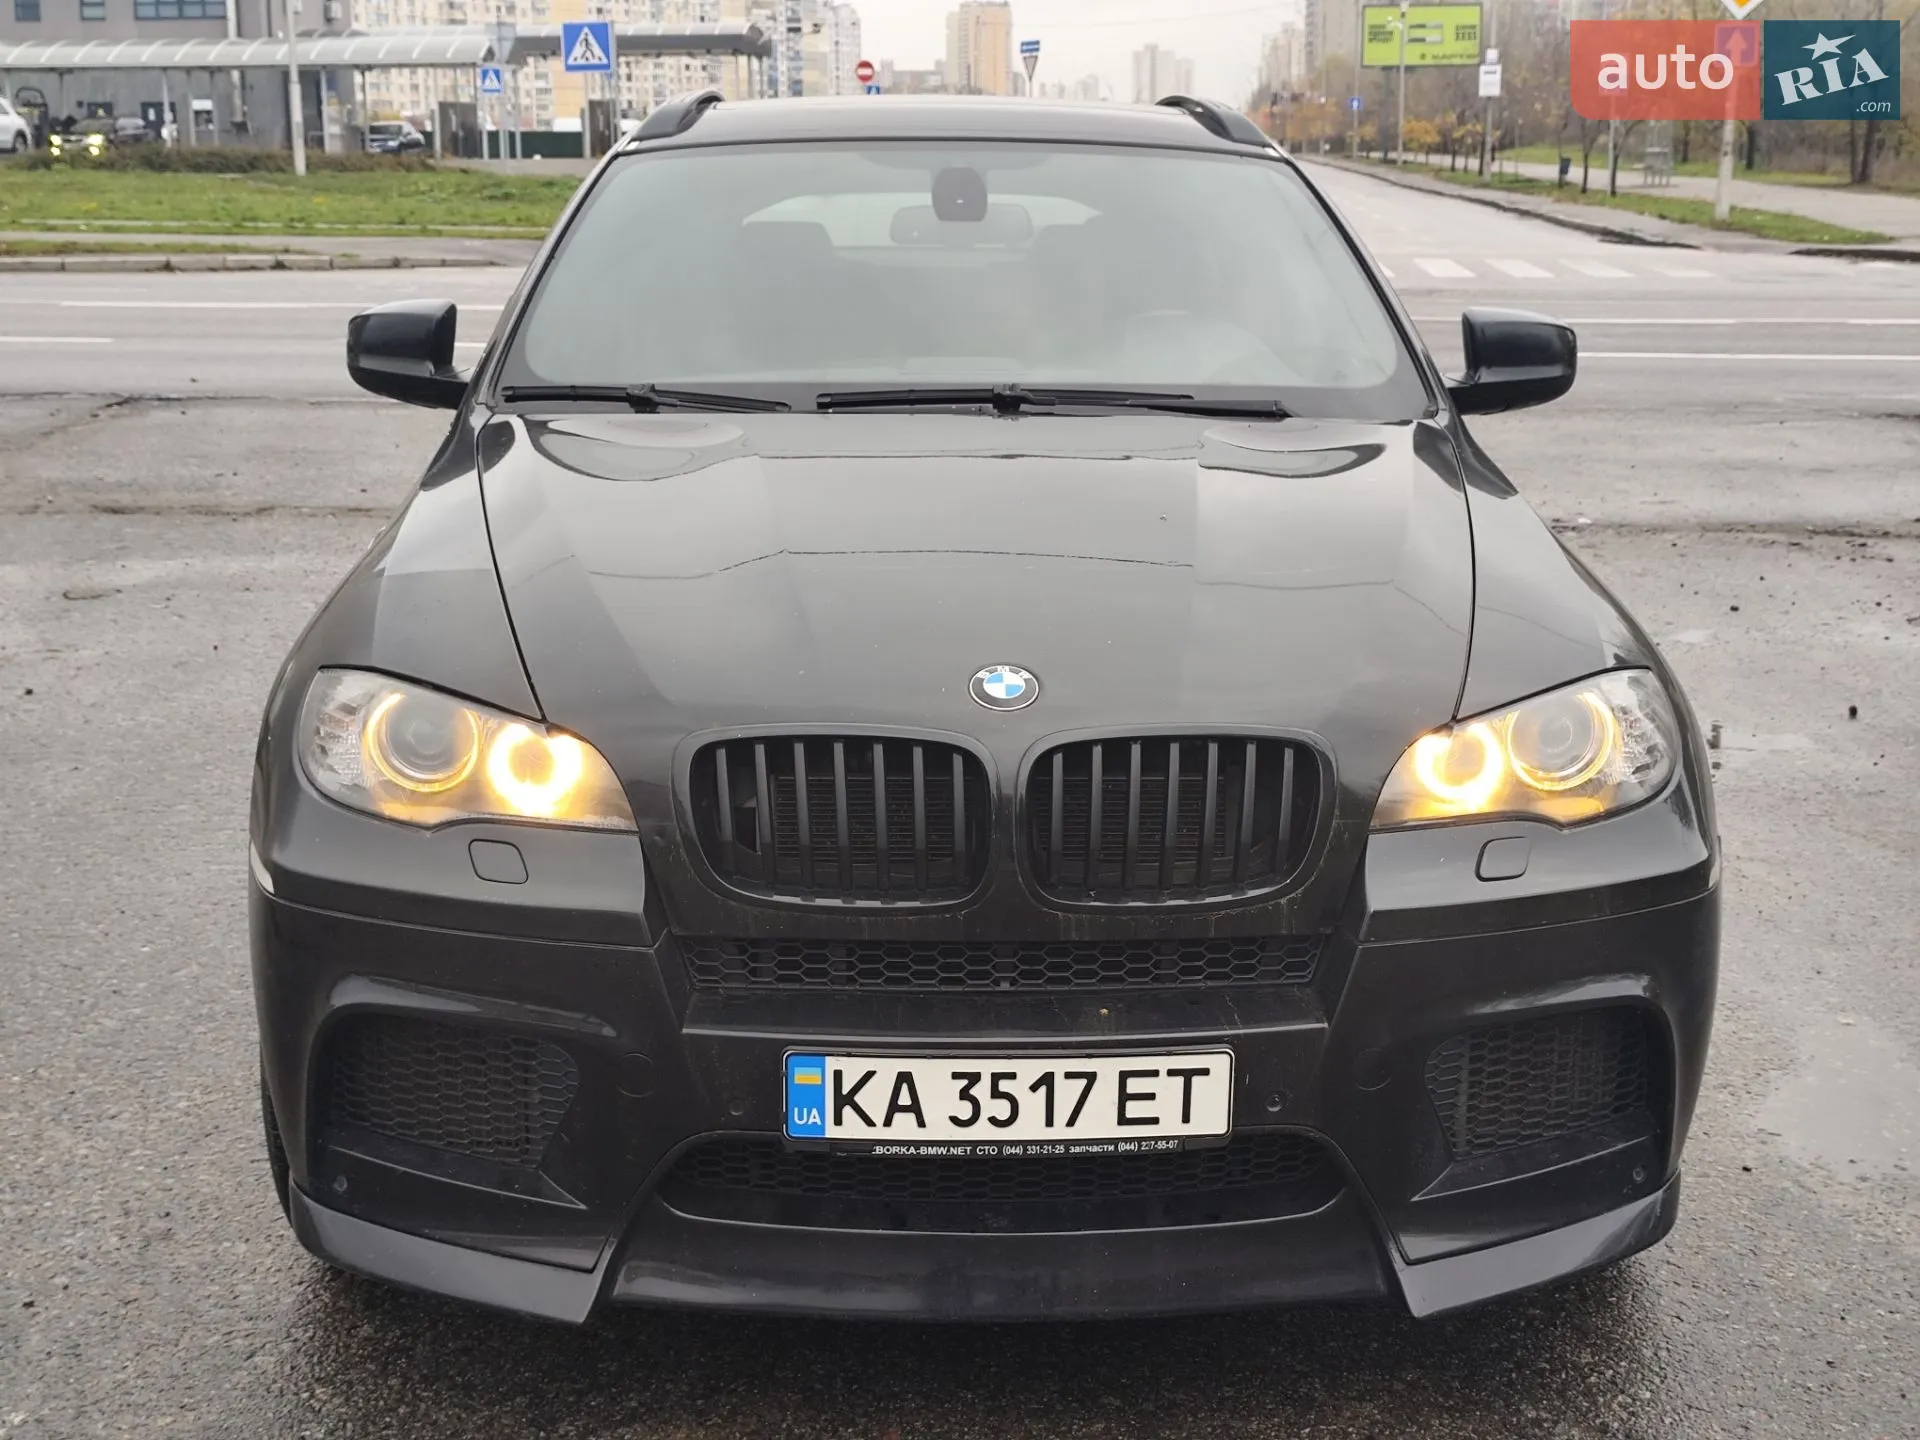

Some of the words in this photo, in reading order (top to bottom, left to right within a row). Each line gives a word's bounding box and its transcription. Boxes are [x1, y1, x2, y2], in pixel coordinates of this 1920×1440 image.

[833, 1069, 926, 1128] KA
[947, 1070, 1098, 1129] 3517
[1117, 1067, 1211, 1126] ET
[793, 1107, 822, 1125] UA
[1002, 1144, 1024, 1156] (044)
[1026, 1144, 1065, 1155] 331-21-25
[1069, 1145, 1115, 1153] запчасти
[1117, 1141, 1139, 1153] (044)
